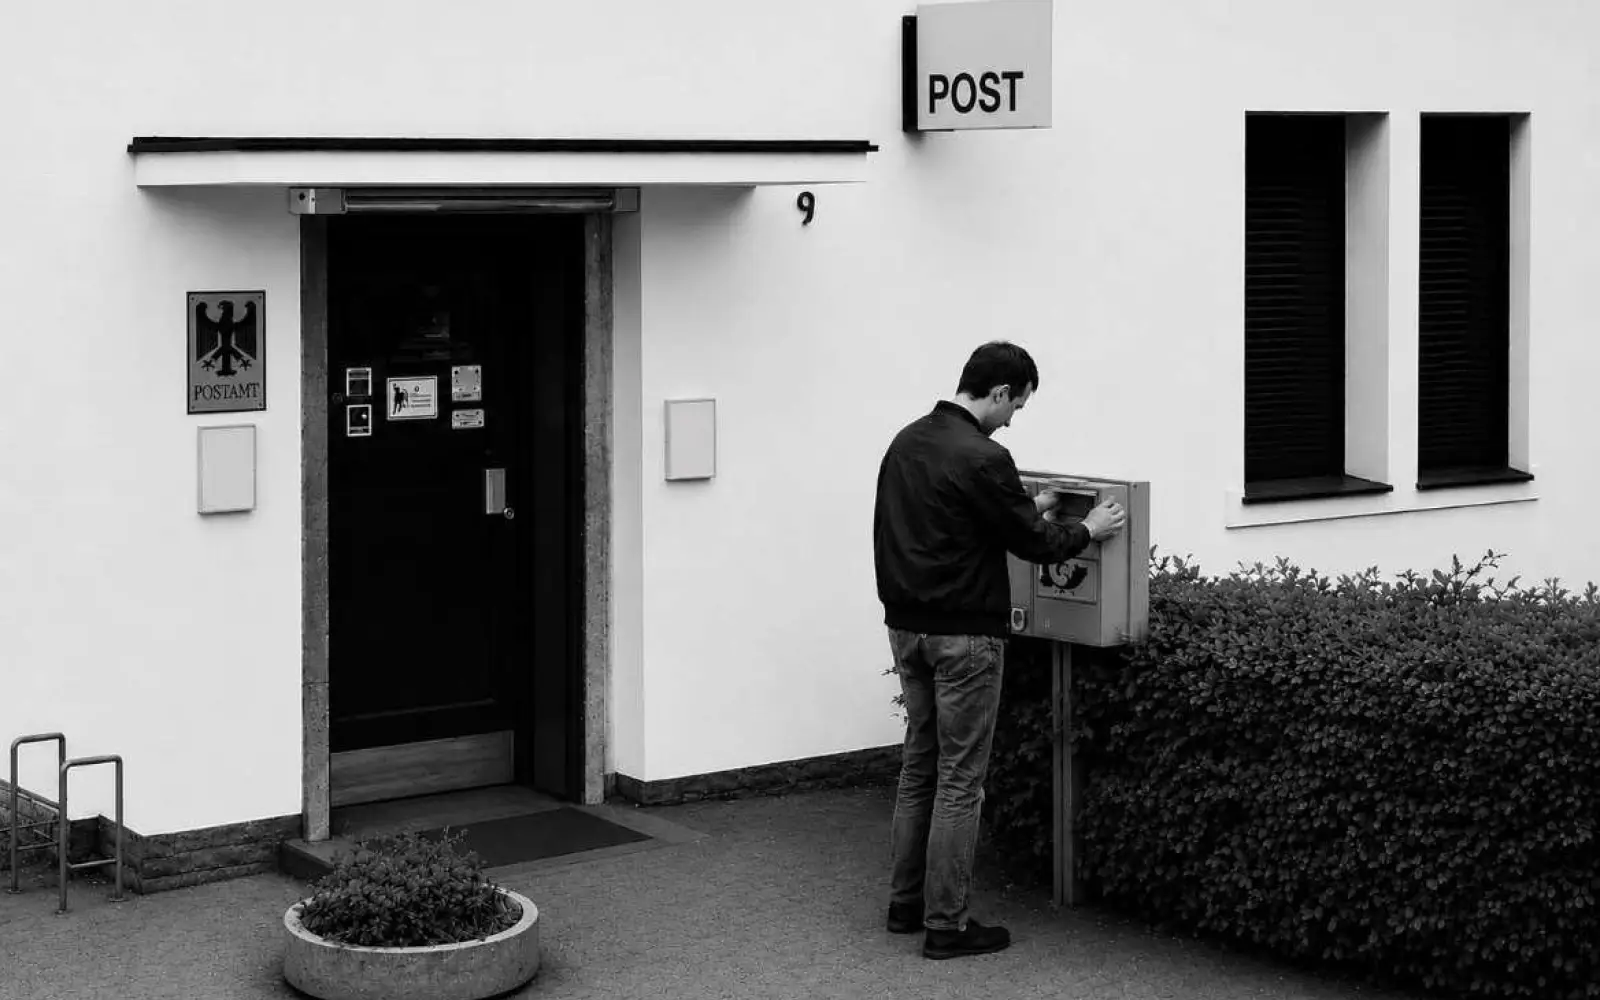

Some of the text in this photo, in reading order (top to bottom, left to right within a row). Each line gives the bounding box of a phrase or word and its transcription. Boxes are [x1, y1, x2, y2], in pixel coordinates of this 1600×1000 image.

[929, 71, 1023, 114] POST
[797, 191, 815, 226] 9
[194, 382, 260, 401] POSTAMT
